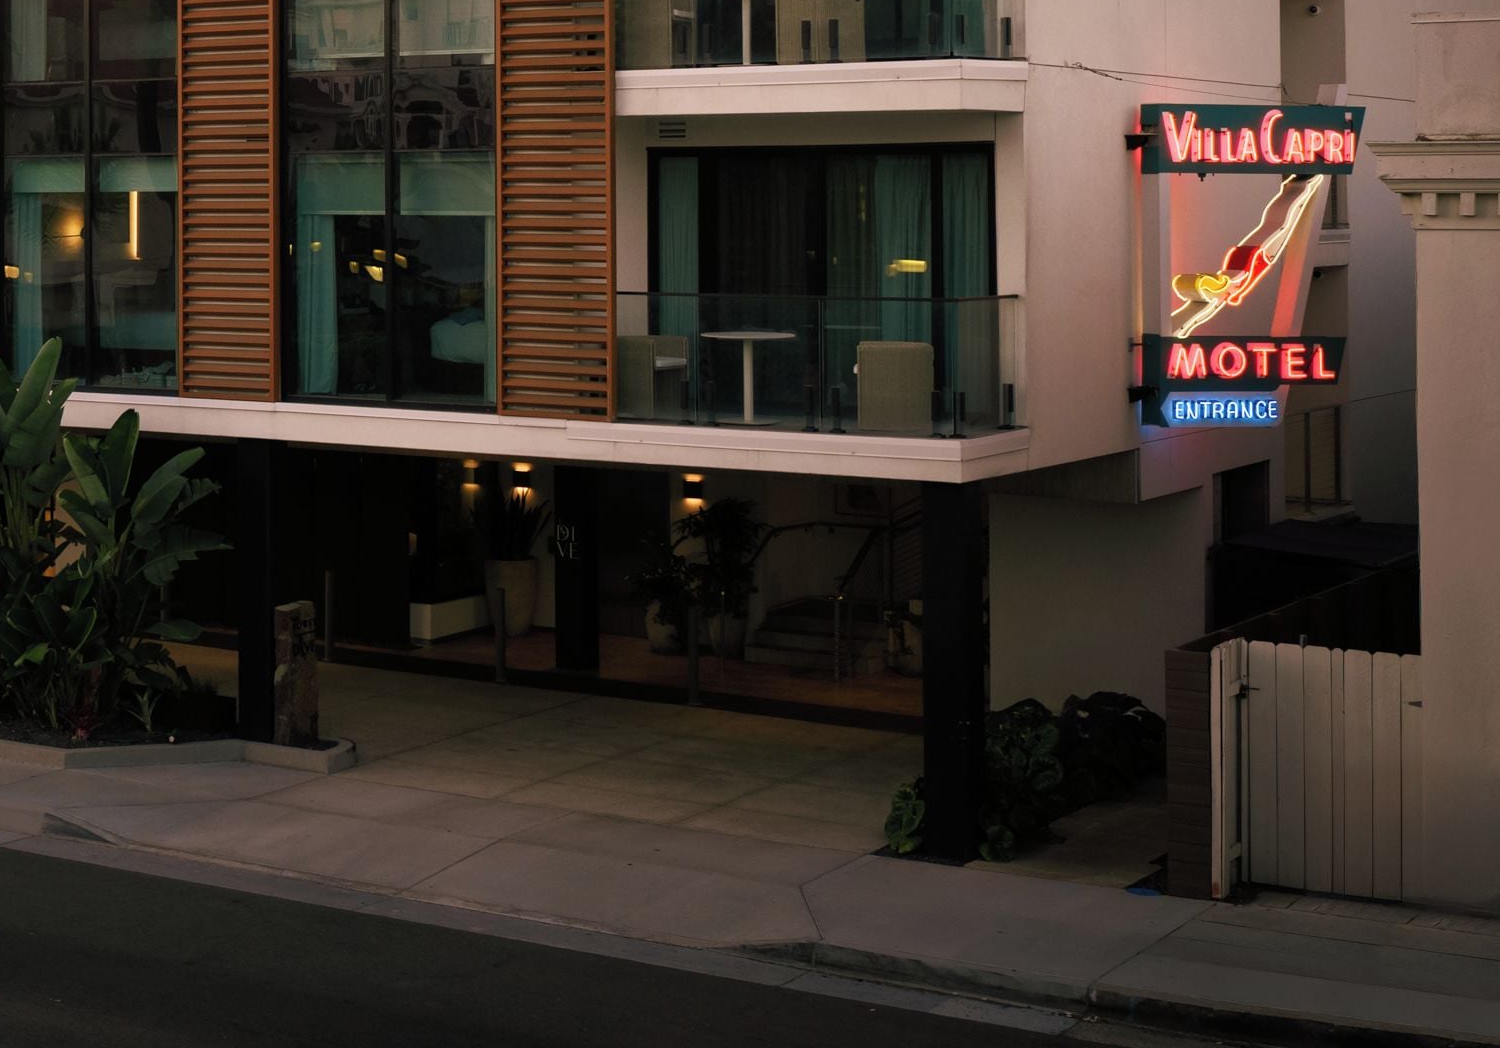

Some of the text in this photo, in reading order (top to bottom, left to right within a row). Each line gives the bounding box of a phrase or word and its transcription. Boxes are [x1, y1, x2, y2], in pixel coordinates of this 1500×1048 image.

[1162, 108, 1356, 164] VILLA CAPRI
[1166, 341, 1337, 380] MOTEL
[1173, 399, 1279, 420] ENTRANCE
